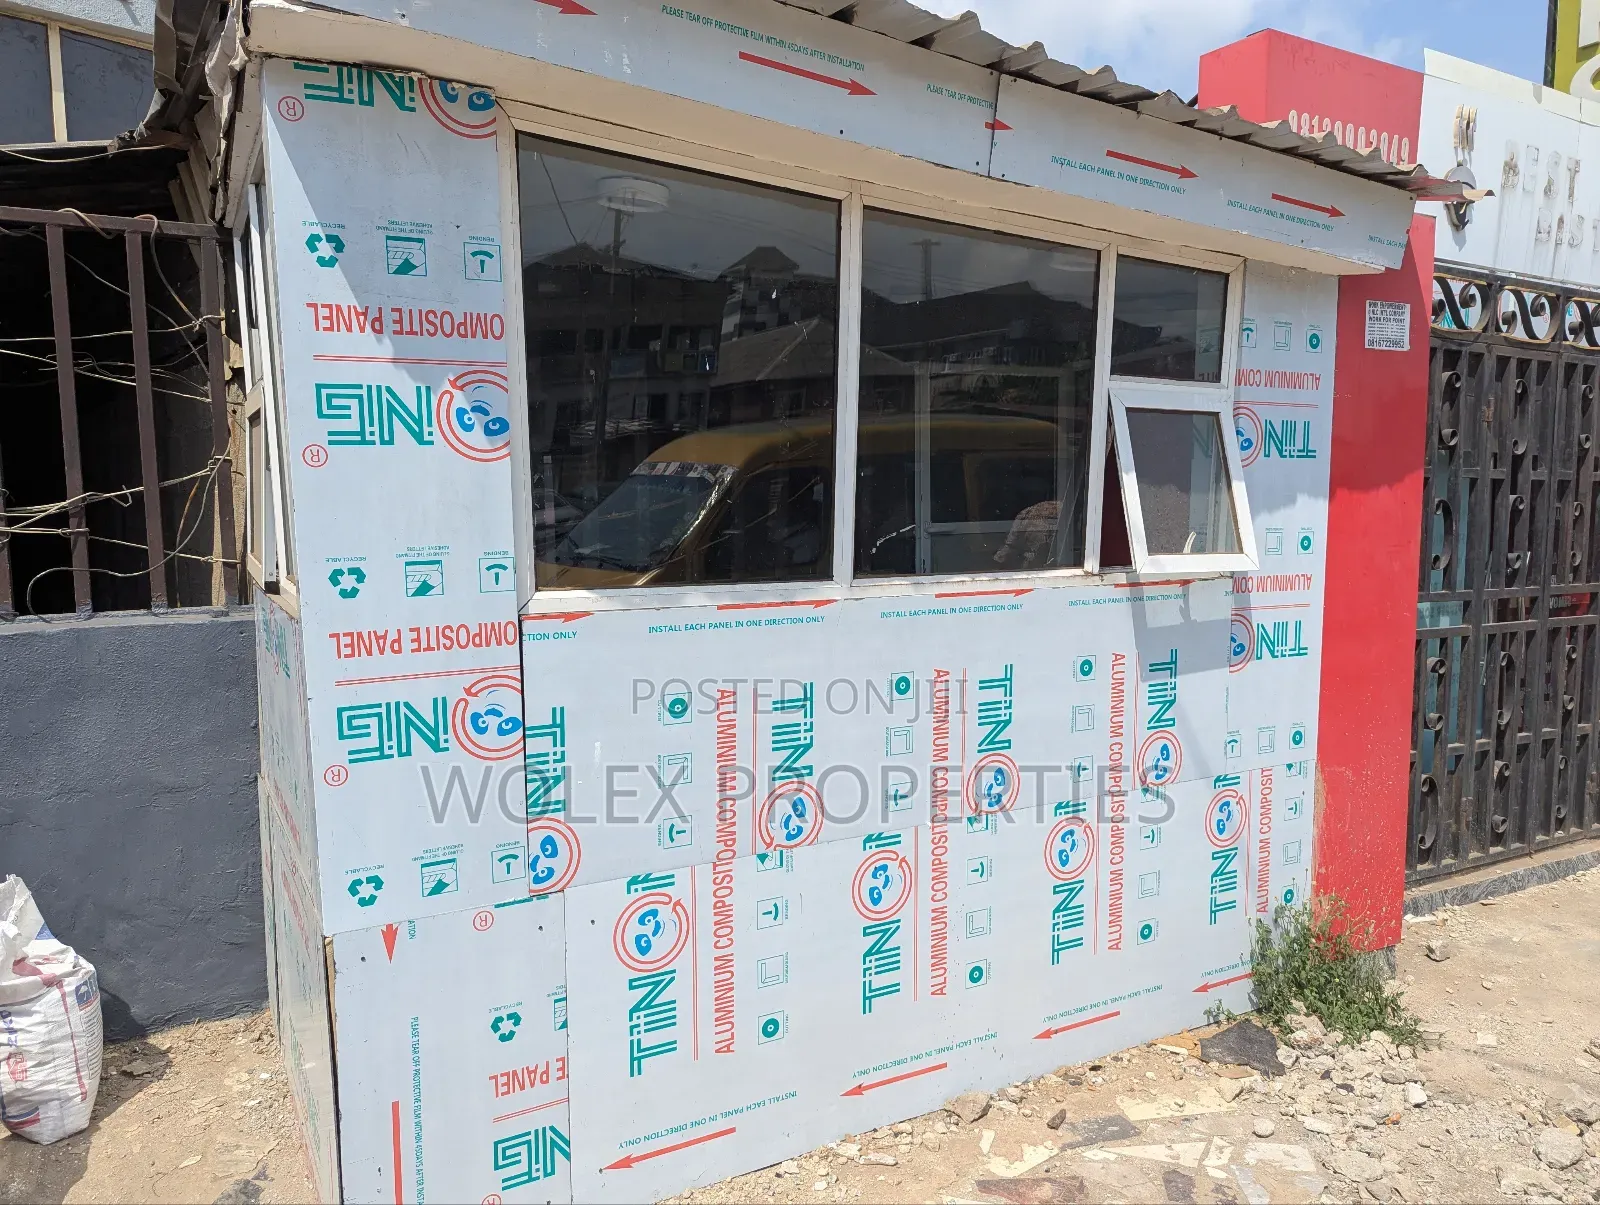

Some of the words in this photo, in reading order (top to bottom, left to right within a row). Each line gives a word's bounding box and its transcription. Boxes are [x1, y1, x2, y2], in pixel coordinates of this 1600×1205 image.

[661, 4, 685, 18] PLEASE
[683, 11, 702, 23] TEAR
[701, 16, 714, 27] OFF
[713, 20, 749, 37] PROTECTIVE
[749, 31, 764, 42] FILM
[763, 35, 787, 49] WITHIN
[808, 48, 826, 60] AFTER
[825, 54, 865, 72] INSTALLATION
[1050, 155, 1079, 168] INSTALL
[1078, 162, 1095, 172] EACH
[1096, 166, 1117, 178] PANEL
[1116, 171, 1124, 180] IN
[1124, 173, 1138, 183] ONE
[1139, 177, 1170, 191] DIRECTION
[1169, 185, 1186, 195] ONLY
[1226, 199, 1248, 210] INSTALL
[1248, 204, 1262, 213] EACH
[1262, 208, 1279, 218] PANEL
[1285, 214, 1296, 222] ONE
[1295, 216, 1321, 228] DIRECTION
[1320, 223, 1334, 231] ONLY
[301, 220, 345, 229] RECYCLABLE
[306, 302, 384, 334] PANEL
[1264, 370, 1321, 390] ALUMINIUM
[1256, 573, 1312, 594] ALUMINIUM
[880, 610, 907, 618] INSTALL
[973, 604, 1005, 612] DIRECTION
[648, 624, 682, 633] INSTALL
[684, 622, 705, 631] EACH
[708, 621, 733, 629] PANEL
[745, 619, 762, 627] ONE
[764, 616, 803, 625] DIRECTION
[805, 615, 825, 623] ONLY
[552, 630, 577, 639] ONLY
[328, 628, 402, 659] PANEL
[1109, 652, 1126, 738] ALUMINIUM
[932, 668, 950, 763] ALUMINIUM
[716, 689, 737, 793] ALUMINIUM
[344, 863, 384, 875] RECYCLABLE
[1255, 837, 1271, 914] ALUMINIUM
[1107, 868, 1124, 951] ALUMINIUM
[930, 904, 948, 996] ALUMINIUM
[1199, 969, 1214, 978] ONLY
[1213, 962, 1240, 974] DIRECTION
[1126, 990, 1141, 999] EACH
[1140, 983, 1163, 995] INSTALL
[713, 952, 735, 1054] ALUMINIUM
[1088, 1001, 1101, 1010] ONE
[1109, 994, 1126, 1004] PANEL
[1041, 1013, 1058, 1023] ONLY
[1058, 1005, 1088, 1018] DIRECTION
[410, 1016, 418, 1038] PLEASE
[954, 1039, 972, 1048] EACH
[972, 1031, 998, 1043] INSTALL
[411, 1039, 419, 1054] TEAR
[933, 1044, 954, 1055] PANEL
[909, 1052, 924, 1061] ONE
[871, 1057, 908, 1072] DIRECTION
[489, 1060, 550, 1098] PANEL
[851, 1067, 871, 1078] ONLY
[412, 1068, 421, 1104] PROTECTIVE
[767, 1089, 797, 1104] INSTALL
[413, 1105, 421, 1119] FILM
[719, 1105, 744, 1118] PANEL
[745, 1099, 766, 1111] EACH
[688, 1117, 707, 1128] ONE
[707, 1113, 718, 1122] IN
[414, 1120, 422, 1143] WITHIN
[642, 1122, 688, 1142] DIRECTION
[617, 1136, 642, 1149] ONLY
[415, 1144, 423, 1167] 45DAYS
[415, 1169, 424, 1187] AFTER
